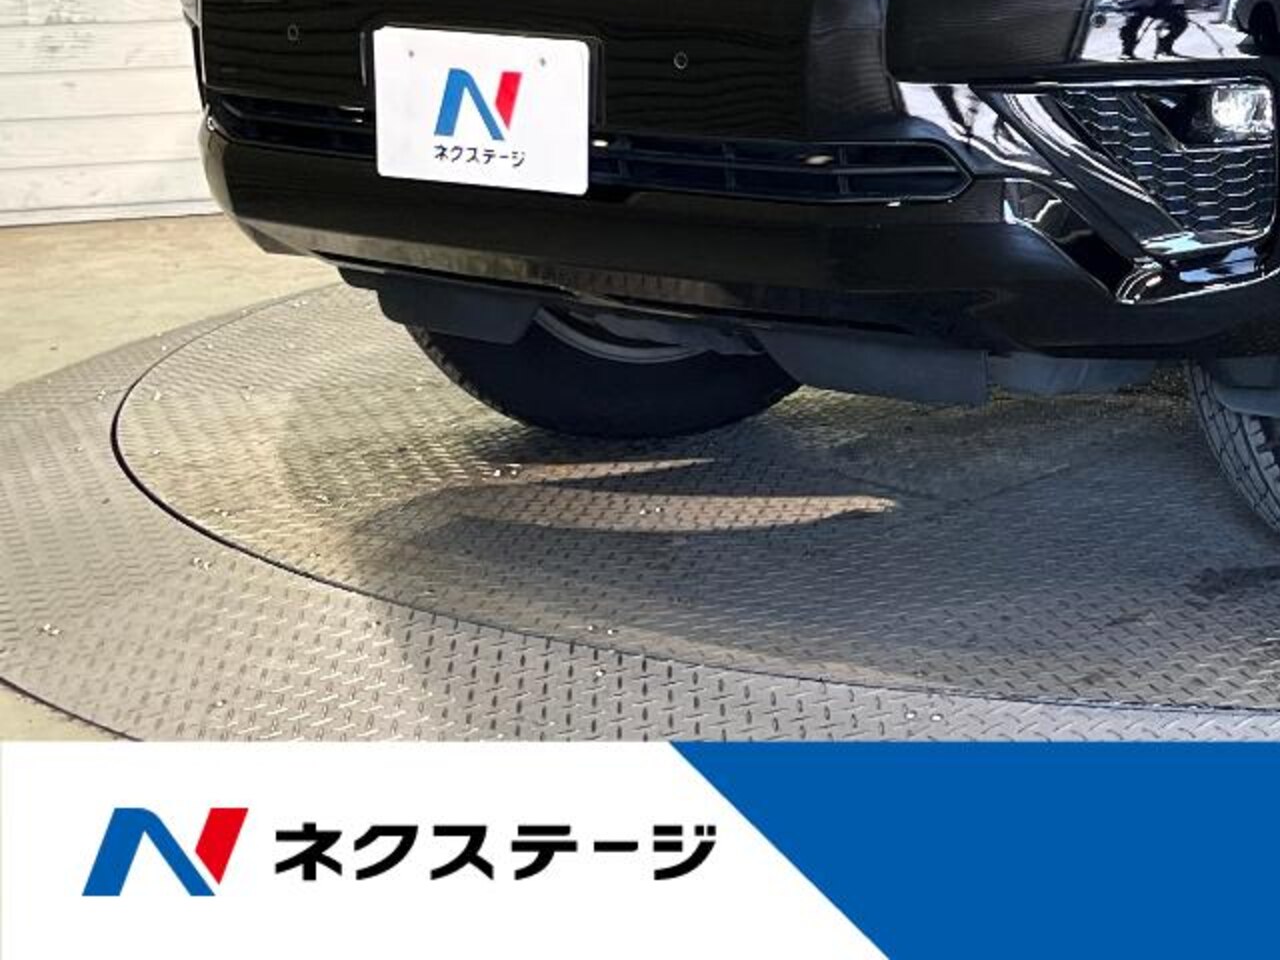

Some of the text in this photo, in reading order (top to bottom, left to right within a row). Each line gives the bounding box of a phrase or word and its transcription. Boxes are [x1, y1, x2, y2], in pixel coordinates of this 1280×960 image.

[433, 144, 526, 168] ネクステージ
